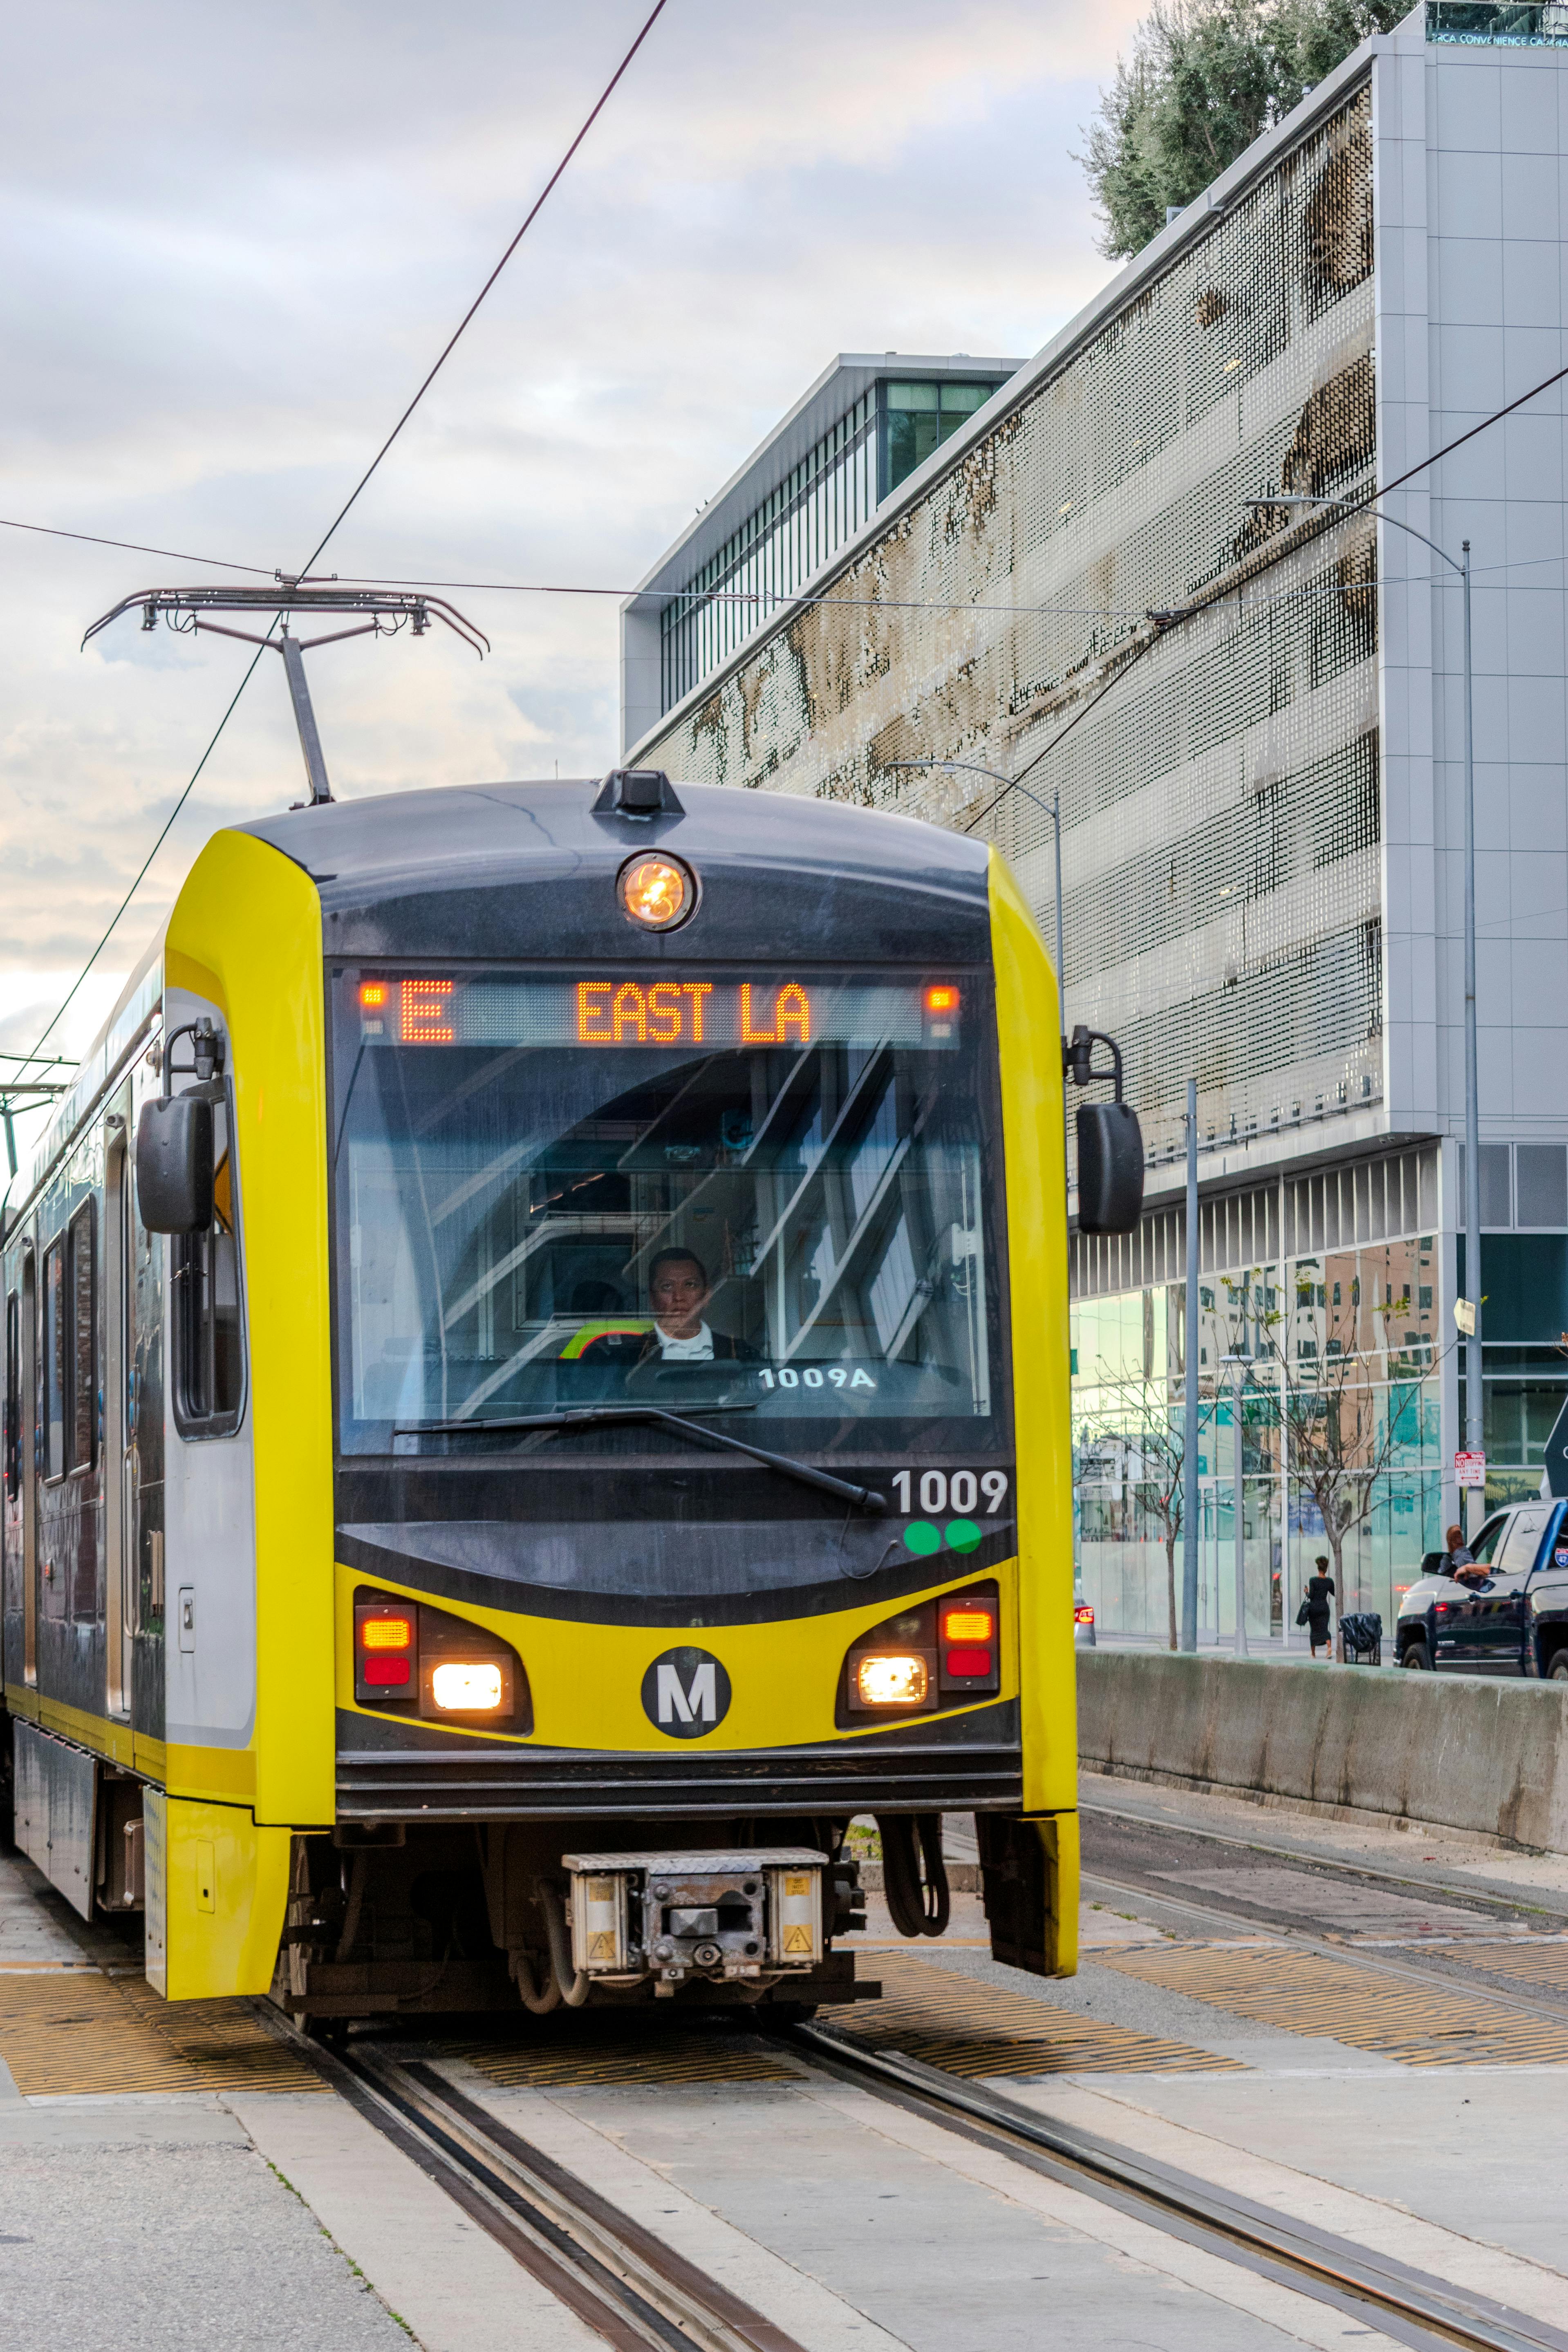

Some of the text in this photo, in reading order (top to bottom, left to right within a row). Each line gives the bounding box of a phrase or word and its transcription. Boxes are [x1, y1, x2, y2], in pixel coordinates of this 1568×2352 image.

[1460, 34, 1527, 46] CONVENIENCE
[402, 981, 452, 1040] E
[578, 982, 809, 1042] EAST LA
[758, 1368, 876, 1388] 1009A
[1455, 1459, 1464, 1467] NO
[892, 1470, 1008, 1513] 1009
[657, 1663, 716, 1723] M
